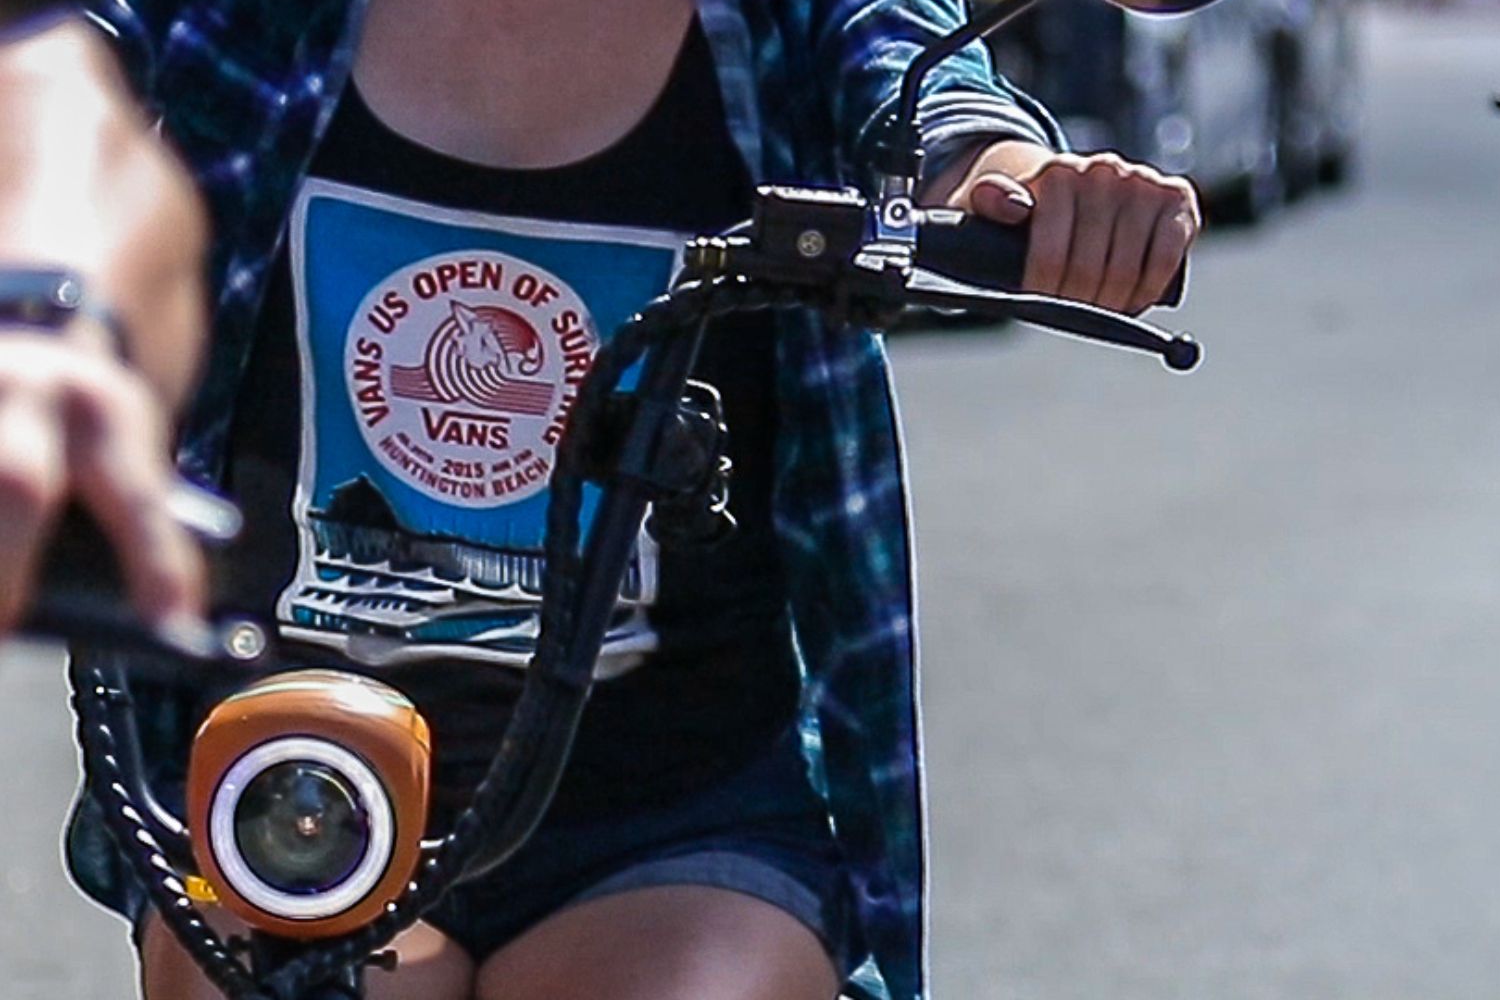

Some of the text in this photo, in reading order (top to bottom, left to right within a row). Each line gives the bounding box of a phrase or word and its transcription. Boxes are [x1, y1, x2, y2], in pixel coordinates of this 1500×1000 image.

[412, 261, 502, 300] OPEN
[512, 273, 560, 308] OF
[367, 291, 409, 335] US
[354, 337, 390, 428] VANS
[421, 407, 511, 450] VANS
[378, 435, 486, 498] HUNTINGTON
[492, 457, 549, 496] BEACH
[441, 458, 485, 479] 2015
